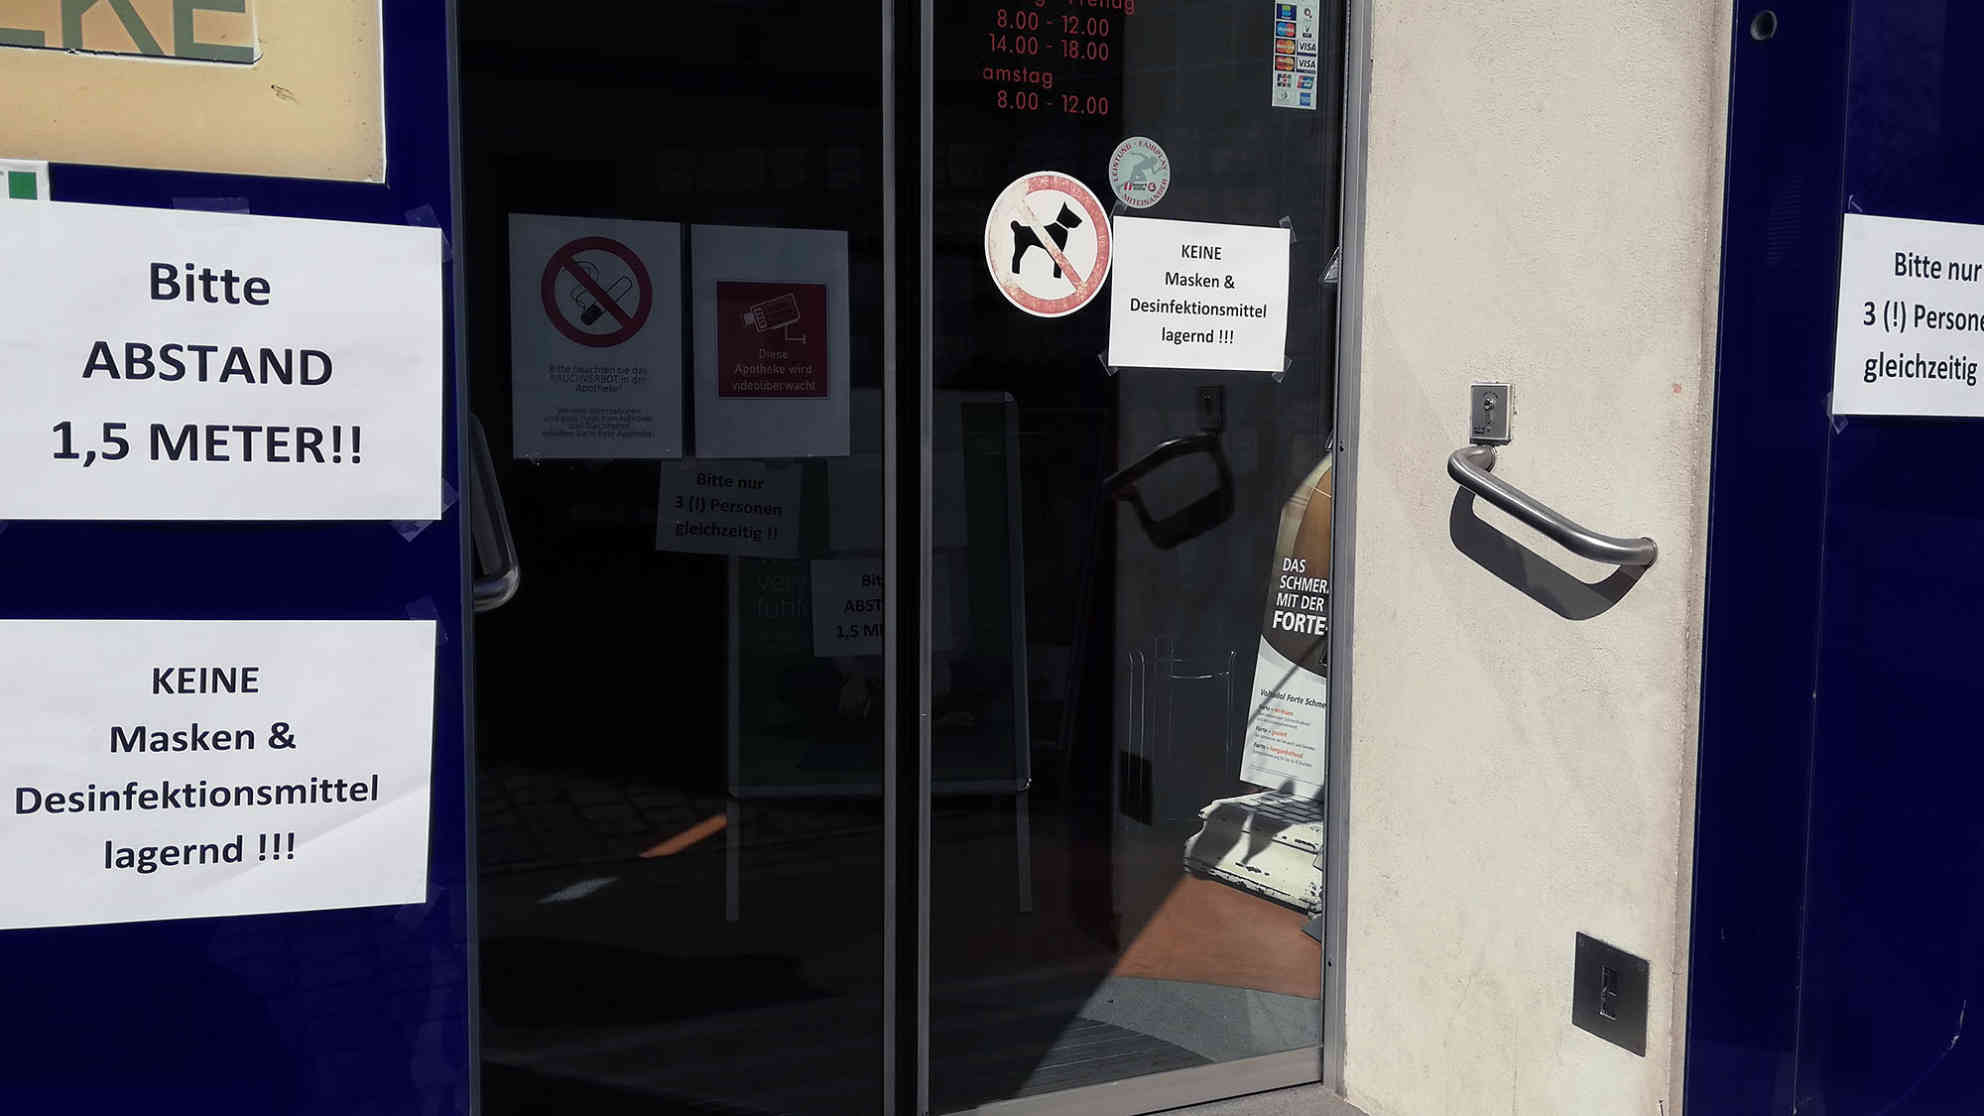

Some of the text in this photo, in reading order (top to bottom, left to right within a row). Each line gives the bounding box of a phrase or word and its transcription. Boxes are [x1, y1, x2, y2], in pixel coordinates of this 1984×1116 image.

[0, 0, 254, 62] KE
[997, 8, 1039, 31] 8.00
[1062, 15, 1109, 37] 12.00
[985, 32, 1038, 55] 14.00
[1061, 39, 1109, 61] 18.00
[997, 89, 1039, 110] 8.00
[1061, 95, 1109, 115] 12.00
[1181, 244, 1222, 261] KEINE
[1164, 271, 1236, 289] Masken &
[1894, 252, 1983, 282] Bitte nur
[150, 262, 271, 305] Bitte
[1130, 297, 1267, 319] Desinfektionsmittel
[1863, 301, 1876, 326] 3
[1883, 300, 1907, 333] (!)
[1161, 326, 1234, 346] lagernd !!!
[82, 341, 333, 386] ABSTAND
[1863, 351, 1978, 387] gleichzeitig
[51, 421, 362, 467] 1,5 METER!!
[696, 472, 764, 488] Bitte nur
[674, 496, 684, 509] 3
[710, 498, 783, 517] Personen
[675, 520, 762, 542] gleichzeitig
[1283, 557, 1306, 573] DAS
[1279, 574, 1329, 594] SCHMER
[1276, 592, 1325, 612] MIT DER
[152, 666, 260, 694] KEINE
[110, 721, 297, 753] Masken &
[15, 774, 379, 815] Desinfektionsmittel
[104, 832, 296, 875] lagernd !!!
